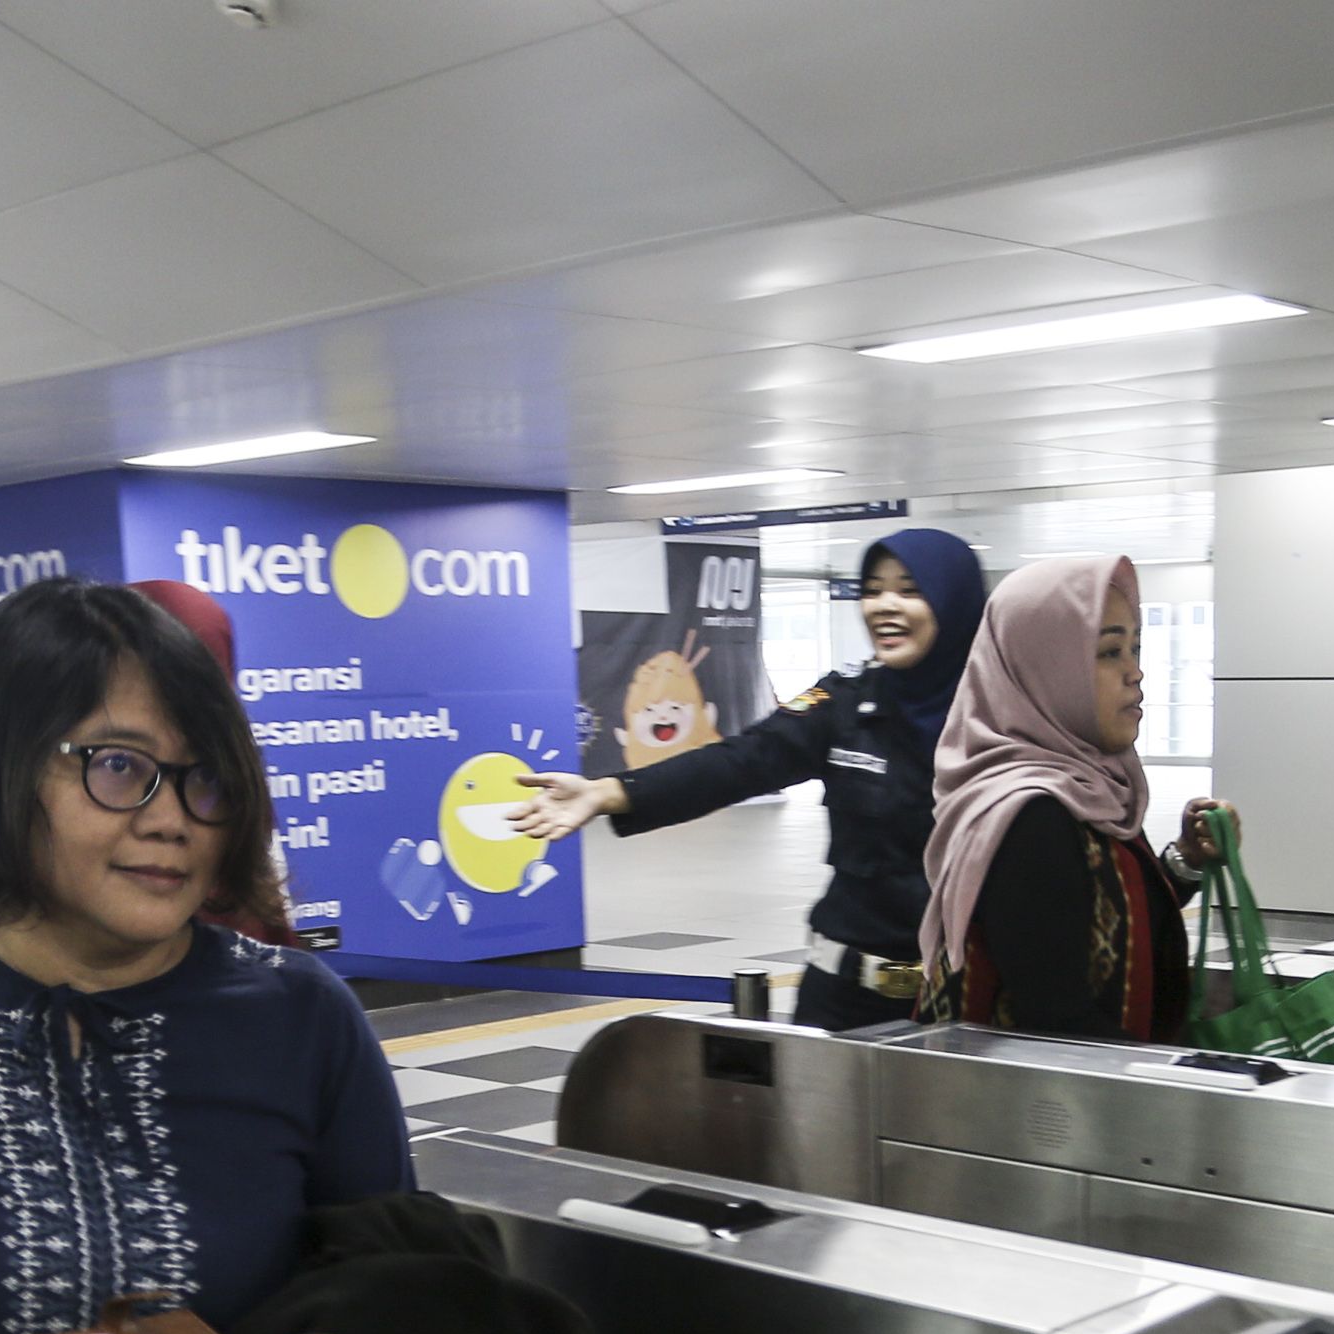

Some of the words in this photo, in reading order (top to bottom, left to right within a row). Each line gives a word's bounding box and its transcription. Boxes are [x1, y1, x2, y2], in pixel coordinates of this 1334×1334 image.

[236, 657, 363, 701] garansi
[370, 707, 460, 742] hotel,
[307, 759, 386, 804] pasti
